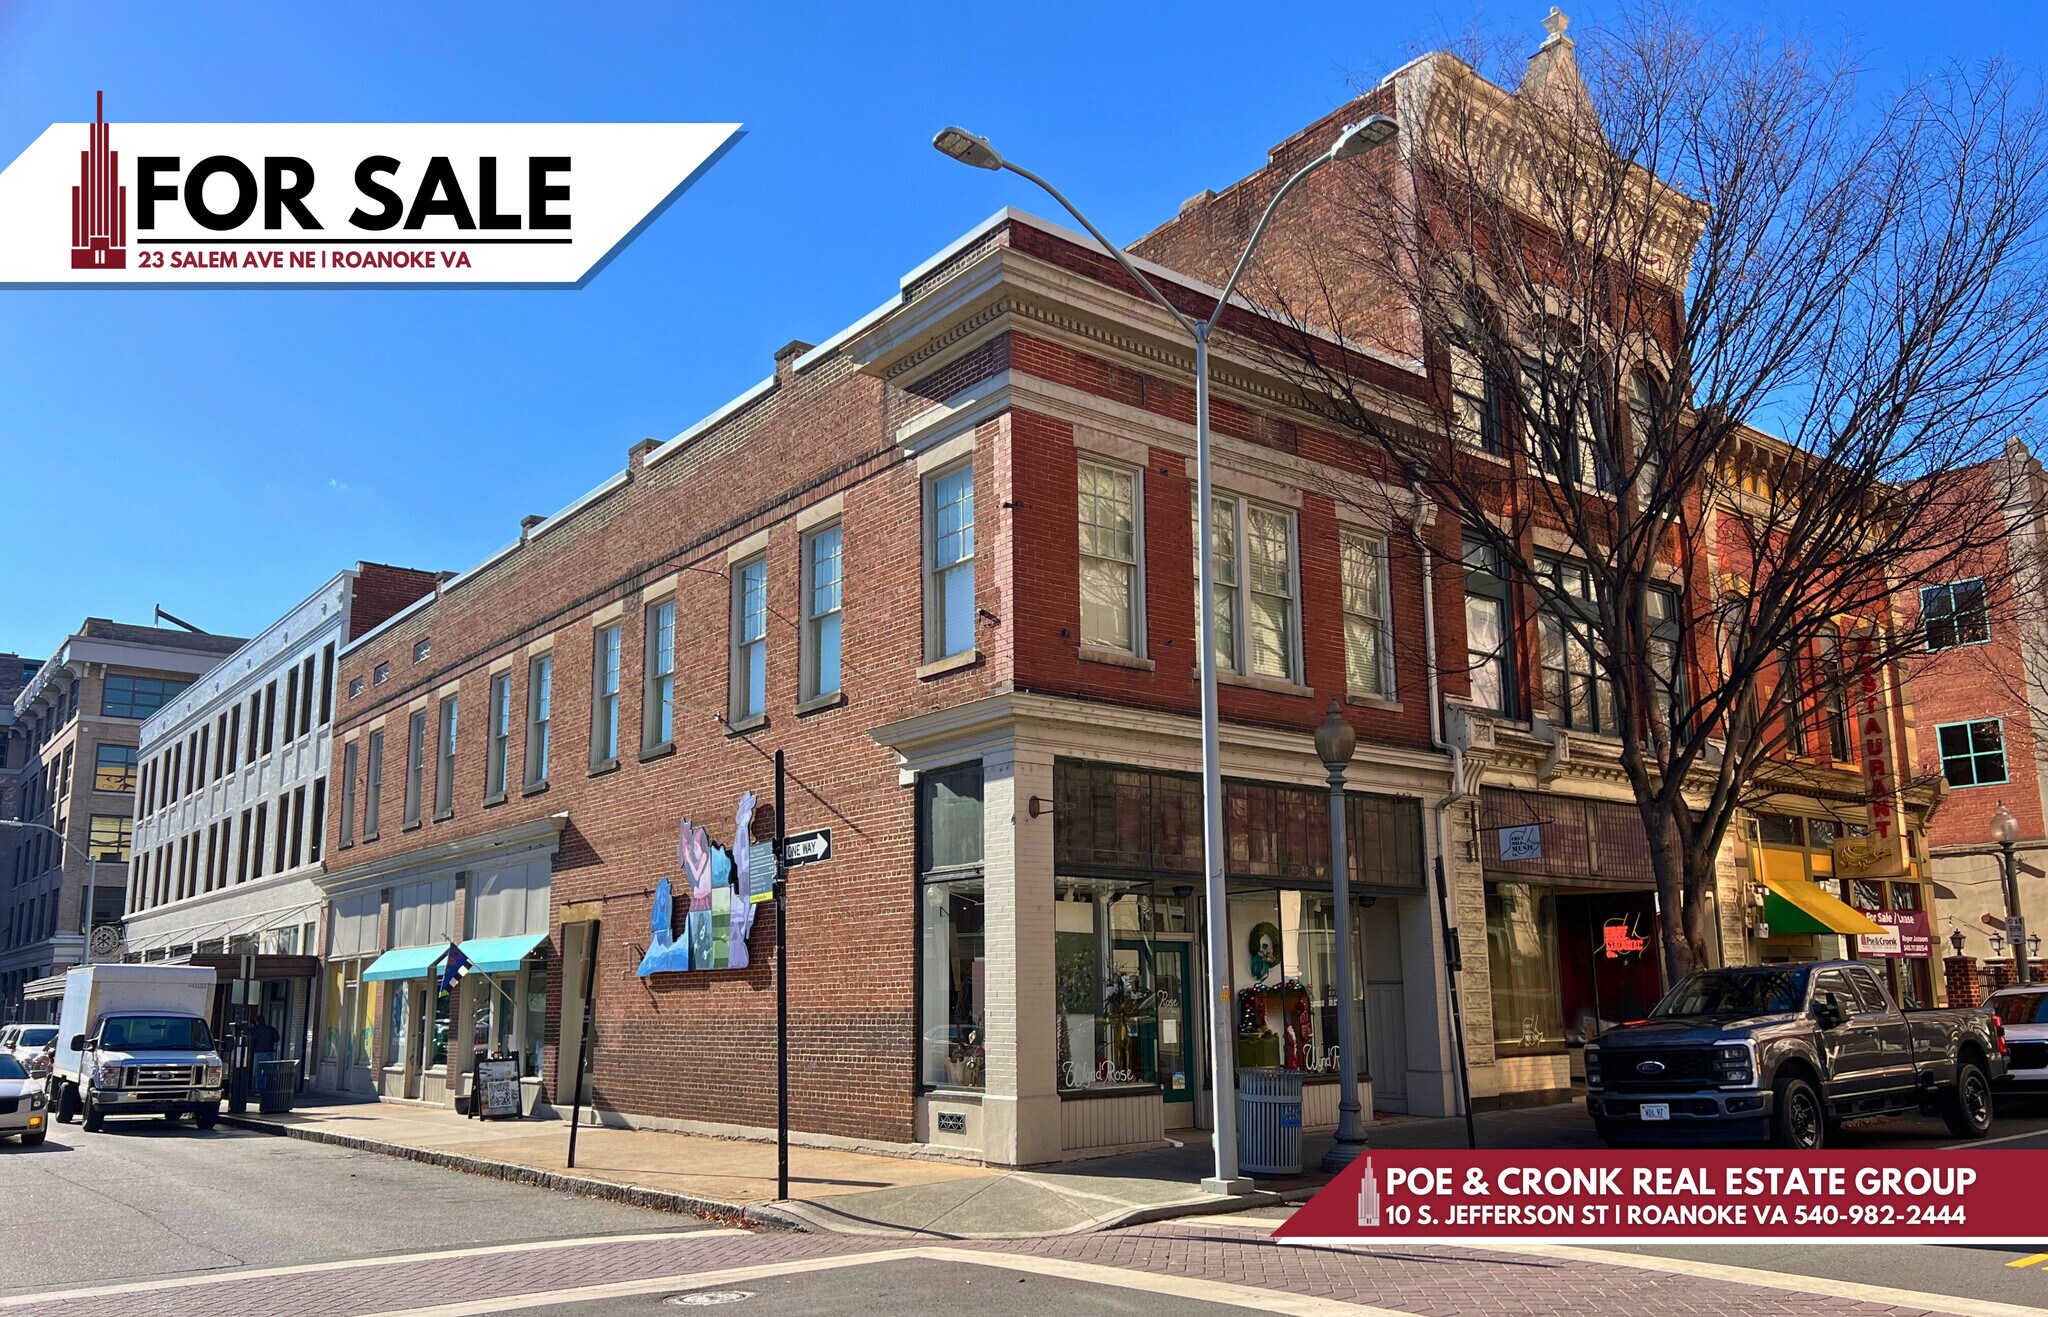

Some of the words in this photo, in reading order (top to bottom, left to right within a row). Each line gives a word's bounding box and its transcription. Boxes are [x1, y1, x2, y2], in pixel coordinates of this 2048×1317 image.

[787, 844, 801, 858] ONE
[802, 841, 816, 855] WAY
[1866, 912, 1876, 922] For
[1877, 912, 1893, 923] Sale
[1606, 940, 1644, 951] MUSIC
[1157, 989, 1179, 1009] Rose
[1102, 1060, 1135, 1084] Rose
